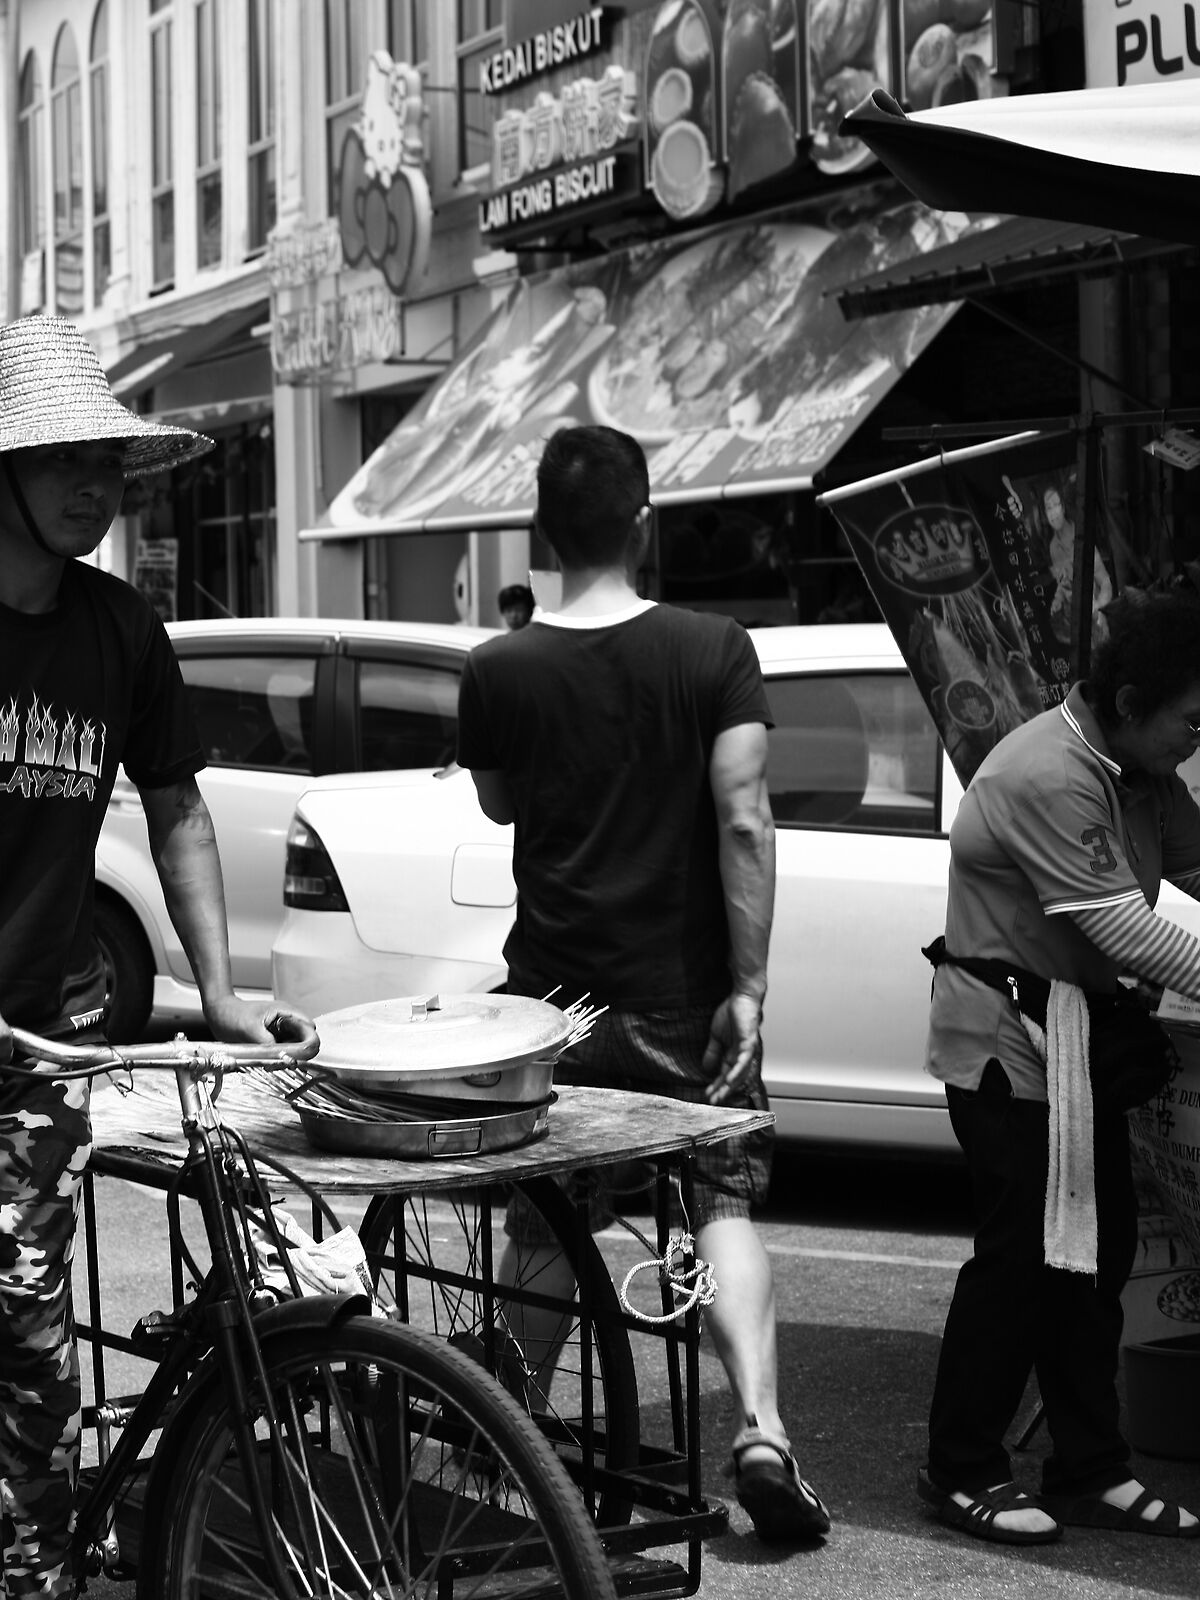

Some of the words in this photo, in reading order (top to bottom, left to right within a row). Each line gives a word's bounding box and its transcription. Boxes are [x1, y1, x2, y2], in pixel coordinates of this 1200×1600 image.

[479, 39, 533, 94] KEDAI
[534, 7, 604, 71] BISKUT
[478, 194, 508, 232] LAM
[510, 179, 552, 222] FONG
[554, 156, 616, 207] BISCUIT
[1080, 826, 1118, 874] 3
